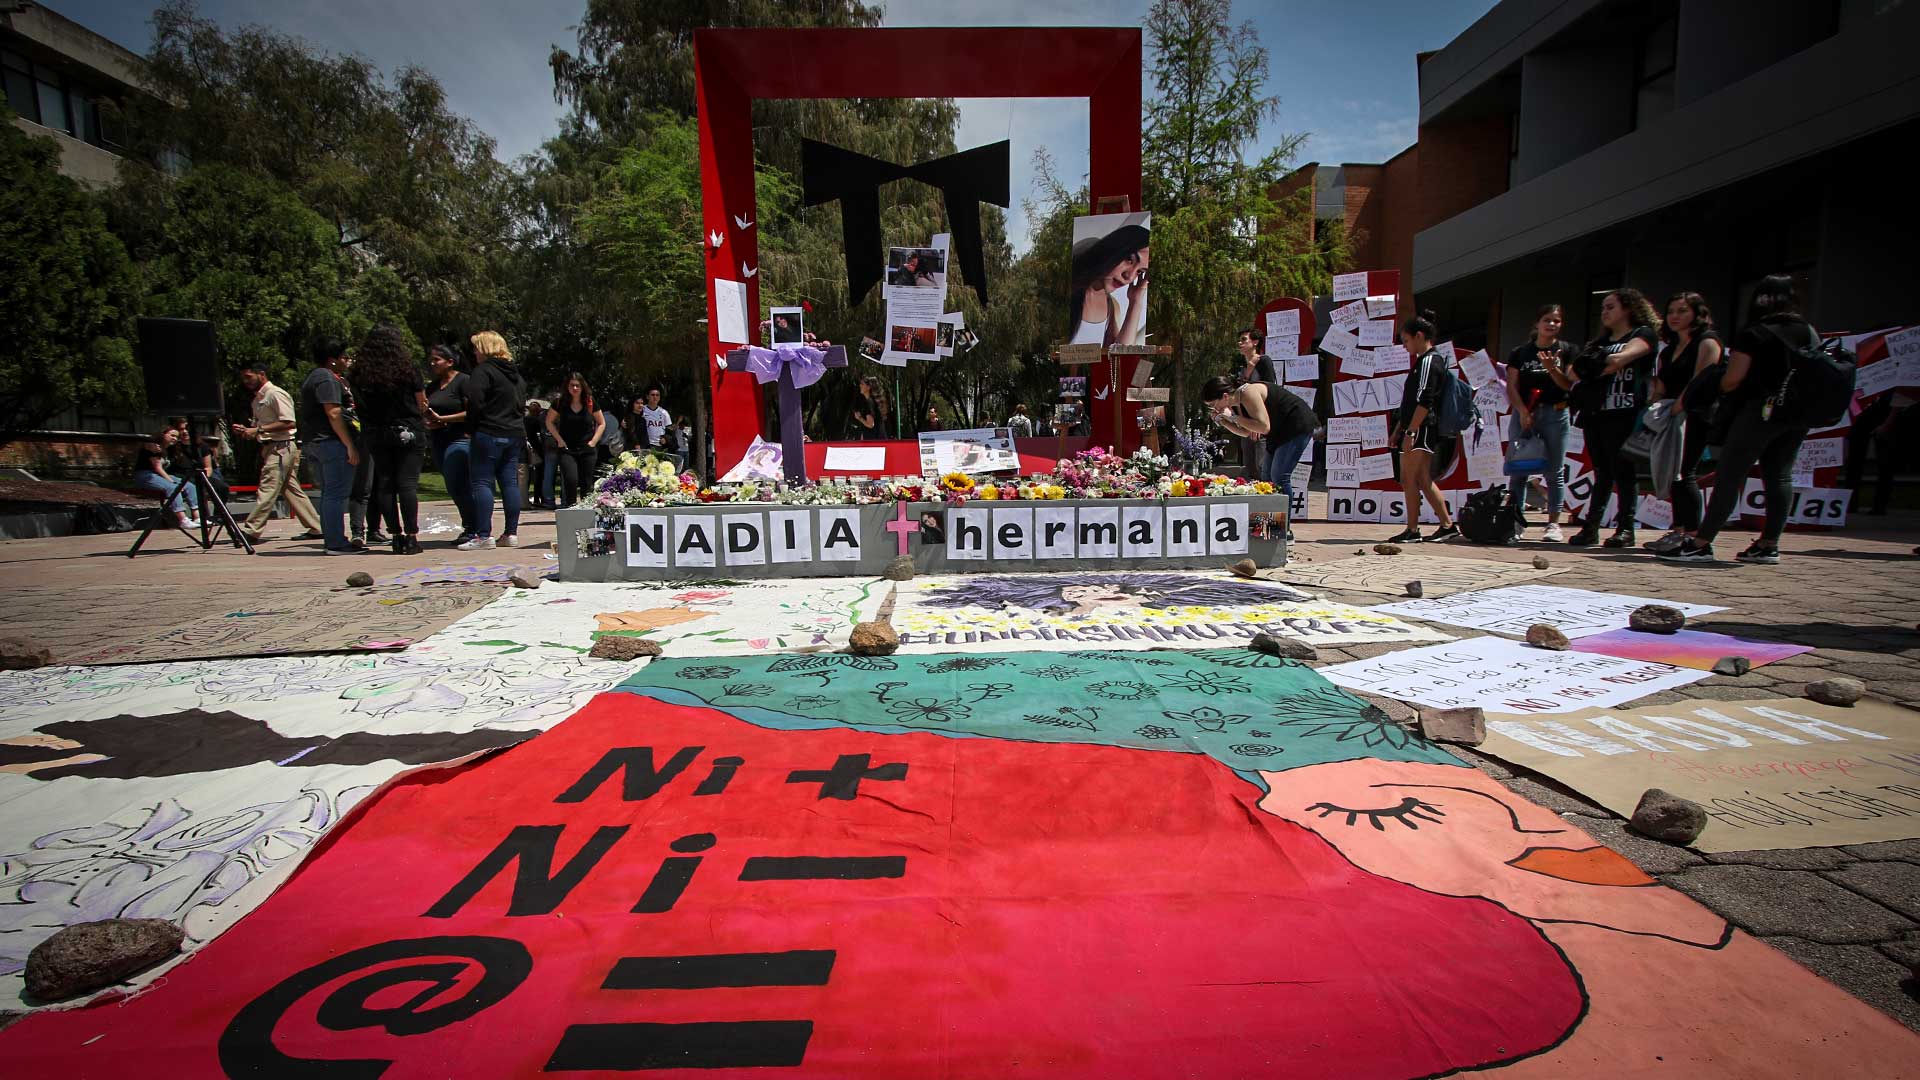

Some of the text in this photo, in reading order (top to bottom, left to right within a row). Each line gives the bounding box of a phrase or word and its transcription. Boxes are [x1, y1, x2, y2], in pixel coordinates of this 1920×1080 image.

[648, 420, 663, 428] AIA
[629, 516, 1241, 554] NADIA hermana
[1378, 686, 1434, 701] En
[1432, 670, 1465, 687] el
[1426, 697, 1476, 706] las
[1501, 697, 1564, 713] NO
[1486, 706, 1892, 758] NADIA
[554, 745, 744, 803] Ni
[418, 824, 717, 918] Ni
[218, 934, 534, 1080] @
